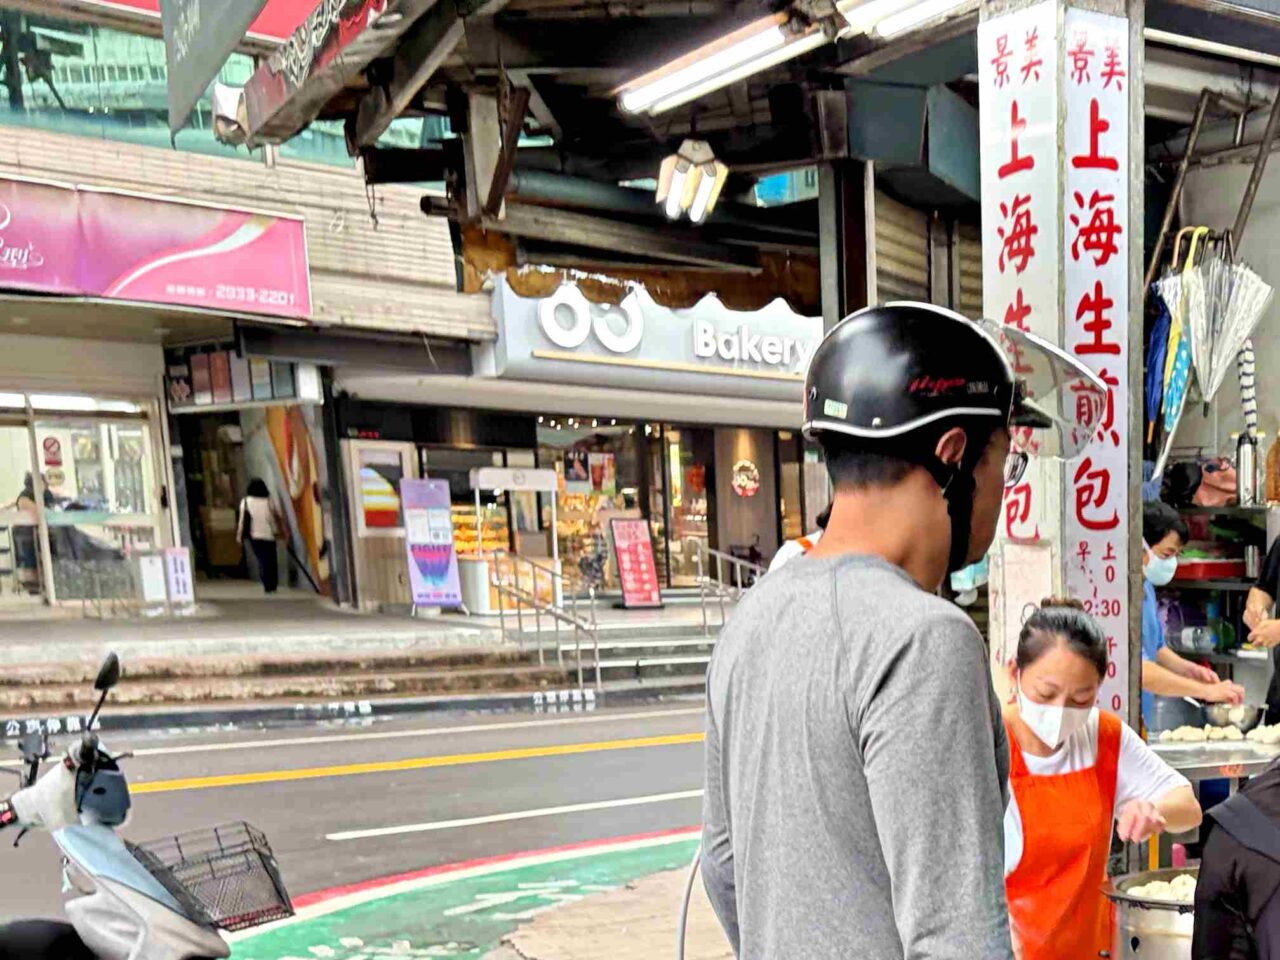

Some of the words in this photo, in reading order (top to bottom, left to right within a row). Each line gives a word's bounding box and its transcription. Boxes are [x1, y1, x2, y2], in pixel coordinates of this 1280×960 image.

[991, 26, 1044, 88] 景美
[1066, 31, 1126, 92] 景美
[997, 99, 1041, 542] 上海生包
[1069, 97, 1123, 531] 上海生煎包
[692, 318, 817, 375] Bakery
[1076, 540, 1117, 561] 早上
[1083, 599, 1121, 617] 2:30
